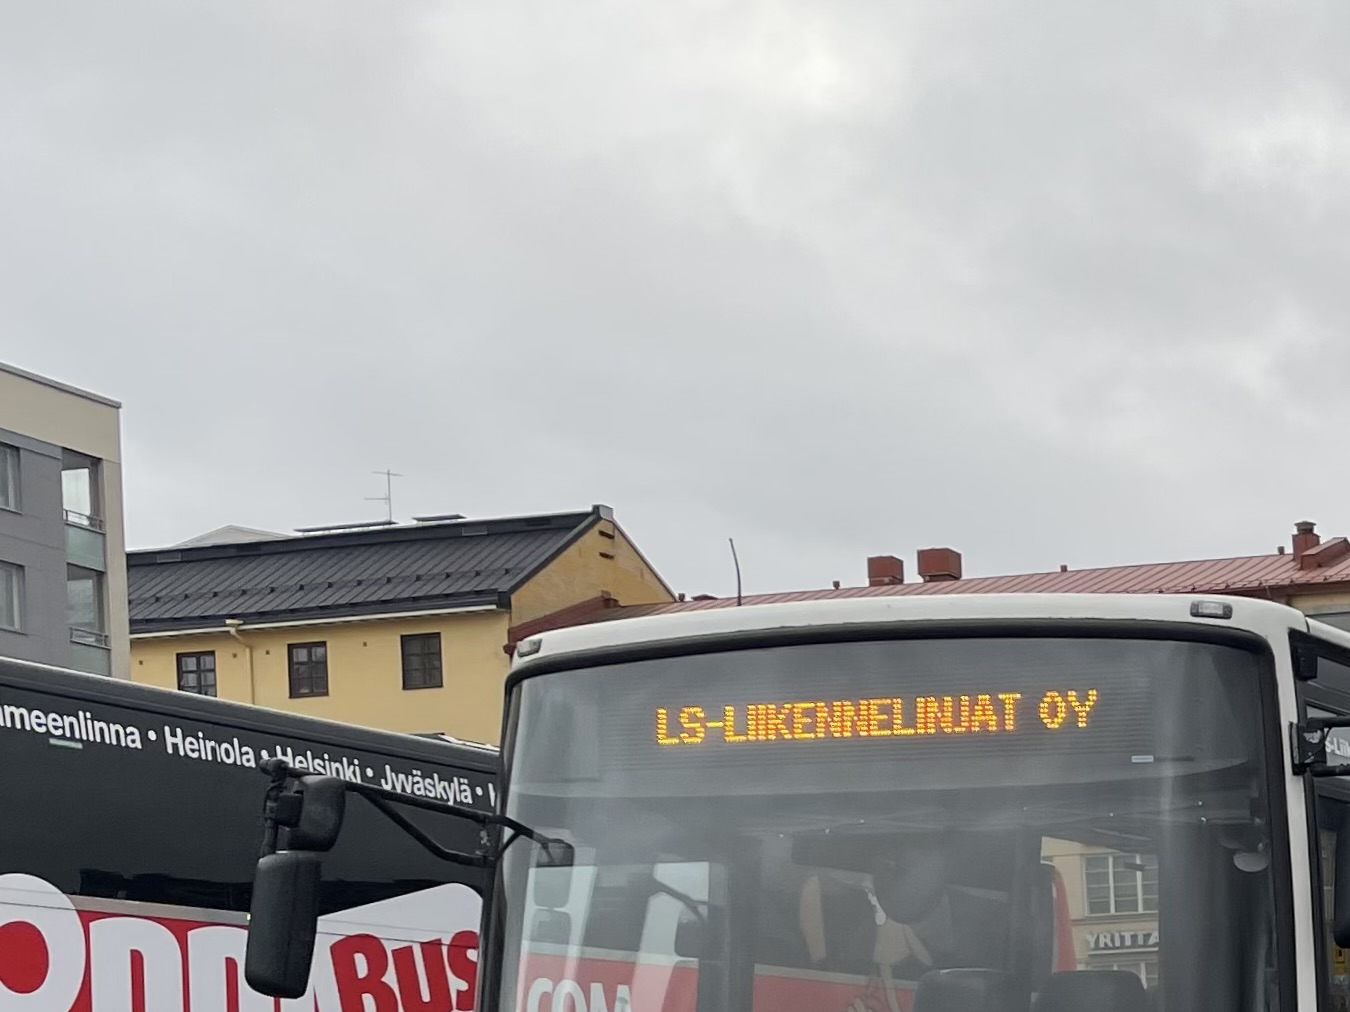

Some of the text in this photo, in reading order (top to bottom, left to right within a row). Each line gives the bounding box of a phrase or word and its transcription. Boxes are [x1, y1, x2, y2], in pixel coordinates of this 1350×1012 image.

[0, 704, 142, 749] meenlinna
[164, 725, 256, 768] Heinola
[275, 745, 361, 784] Helsinki
[381, 764, 473, 806] Jyväskylä
[656, 688, 1098, 744] LS-LIIKENNELINJAT OY
